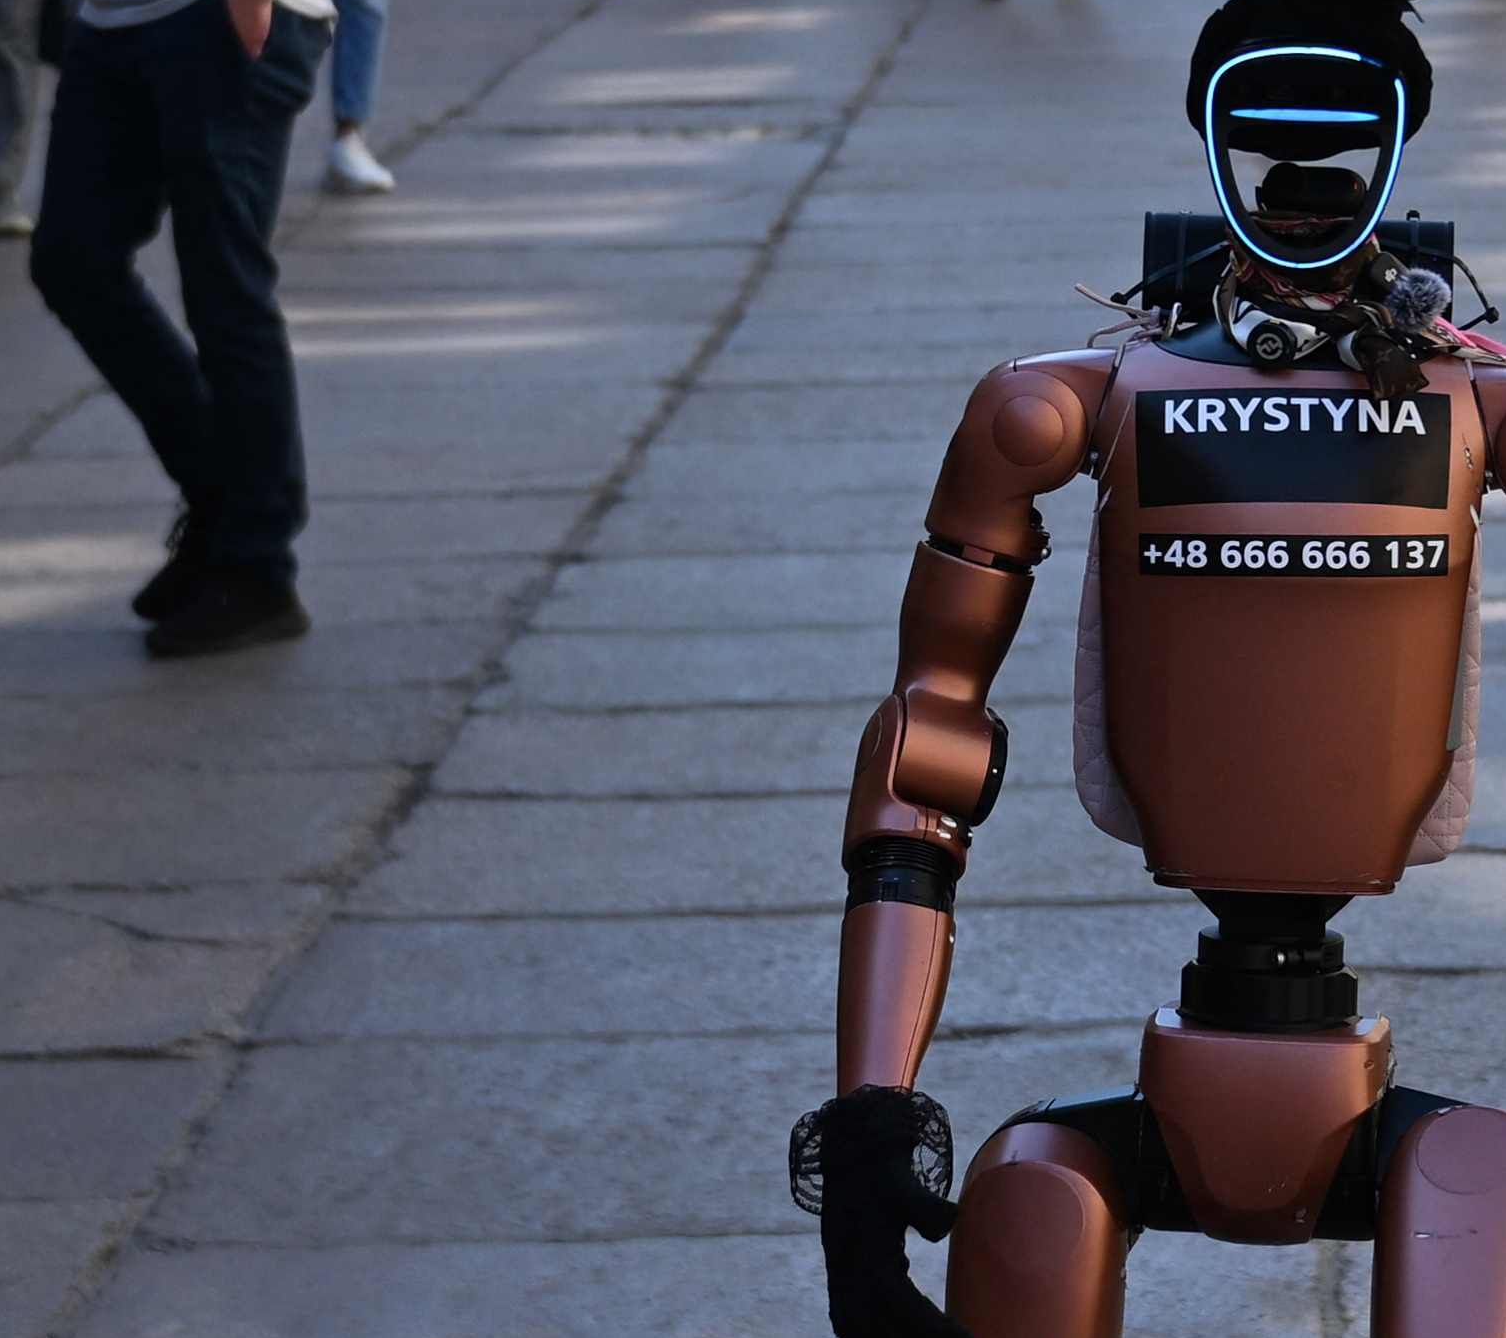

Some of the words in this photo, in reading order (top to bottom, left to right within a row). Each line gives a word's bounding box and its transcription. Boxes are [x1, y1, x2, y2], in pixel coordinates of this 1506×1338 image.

[1163, 396, 1427, 436] KRYSTYNA
[1143, 539, 1208, 569] +48
[1219, 540, 1290, 570] 666
[1301, 541, 1371, 570] 666
[1385, 540, 1445, 570] 137
